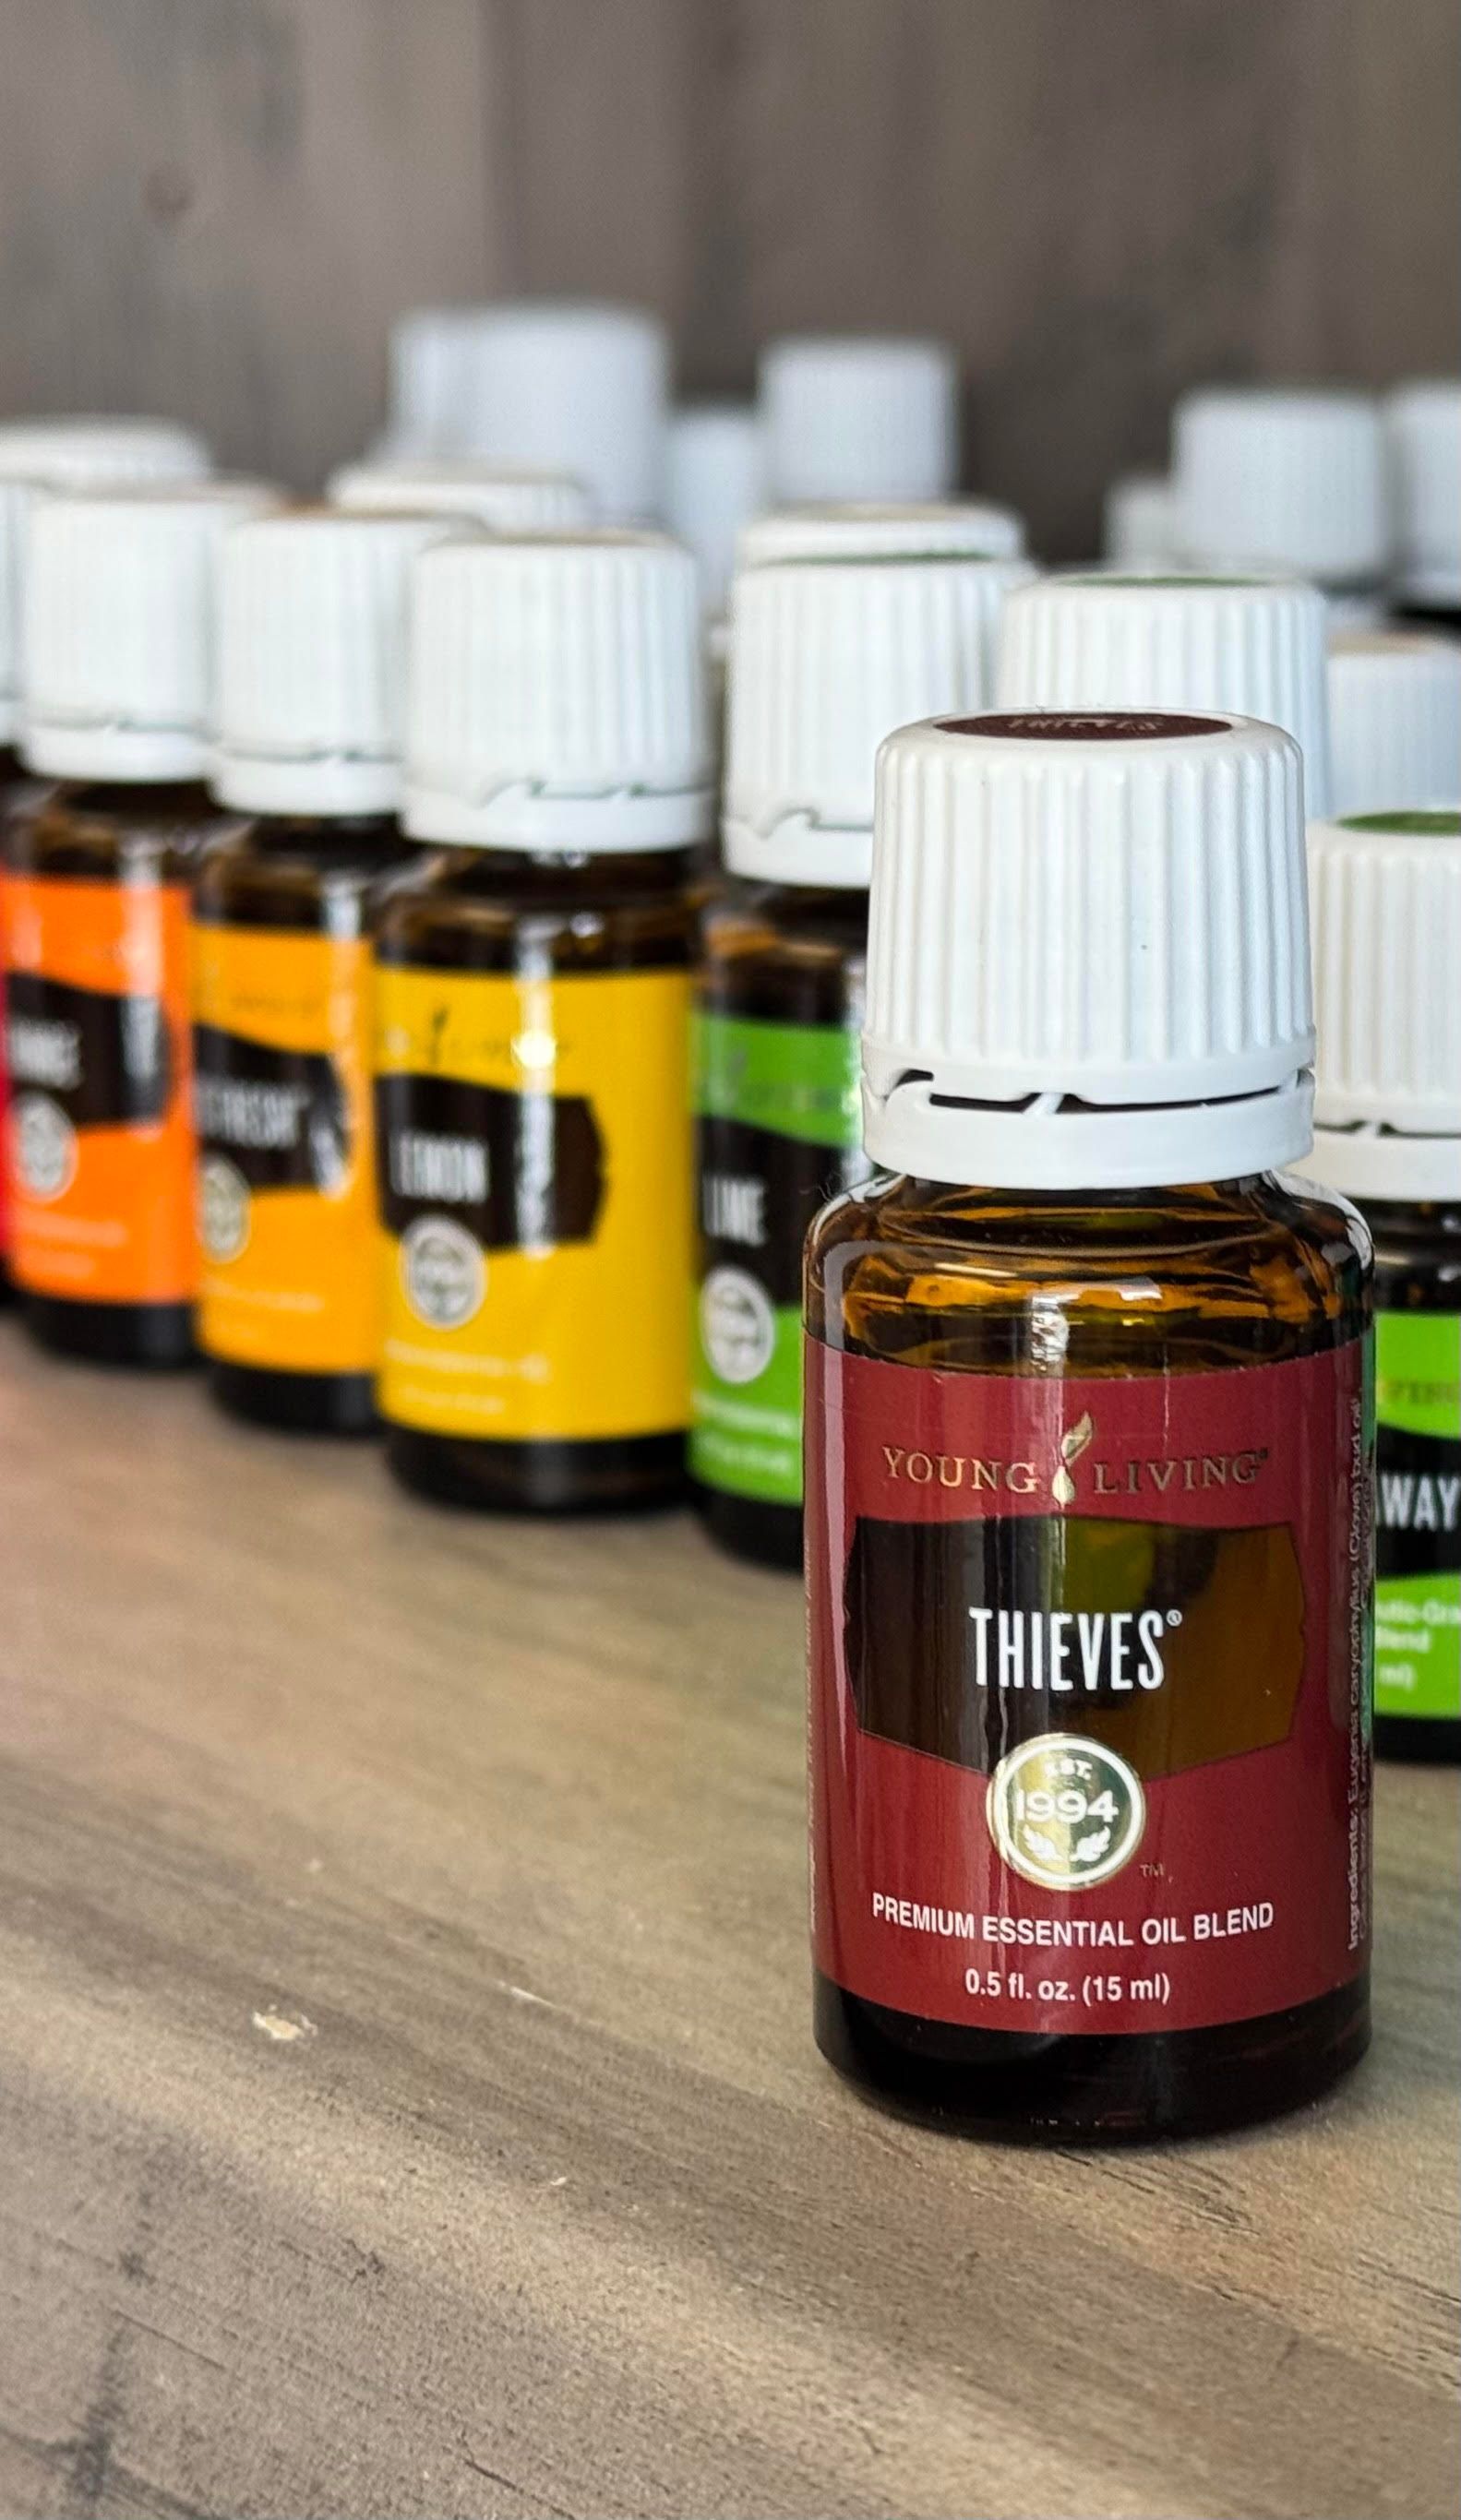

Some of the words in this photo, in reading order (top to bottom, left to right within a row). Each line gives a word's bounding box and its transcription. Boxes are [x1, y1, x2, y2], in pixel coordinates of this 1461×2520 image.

[881, 1446, 1039, 1495] YOUNG
[1375, 1474, 1460, 1532] WAY
[1016, 1789, 1120, 1824] 1994
[1347, 1807, 1360, 1951] Ingredients:
[872, 1892, 975, 1939] PREMIUM
[982, 1916, 1134, 1947] ESSENTIAL
[1142, 1918, 1186, 1945] OIL
[1193, 1901, 1275, 1941] BLEND
[964, 1968, 1001, 1998] 0.5
[1008, 1973, 1032, 2000] fl.
[1037, 1979, 1076, 2002] oz.
[1083, 1974, 1122, 2007] (15
[1130, 1972, 1171, 2005] ml)
